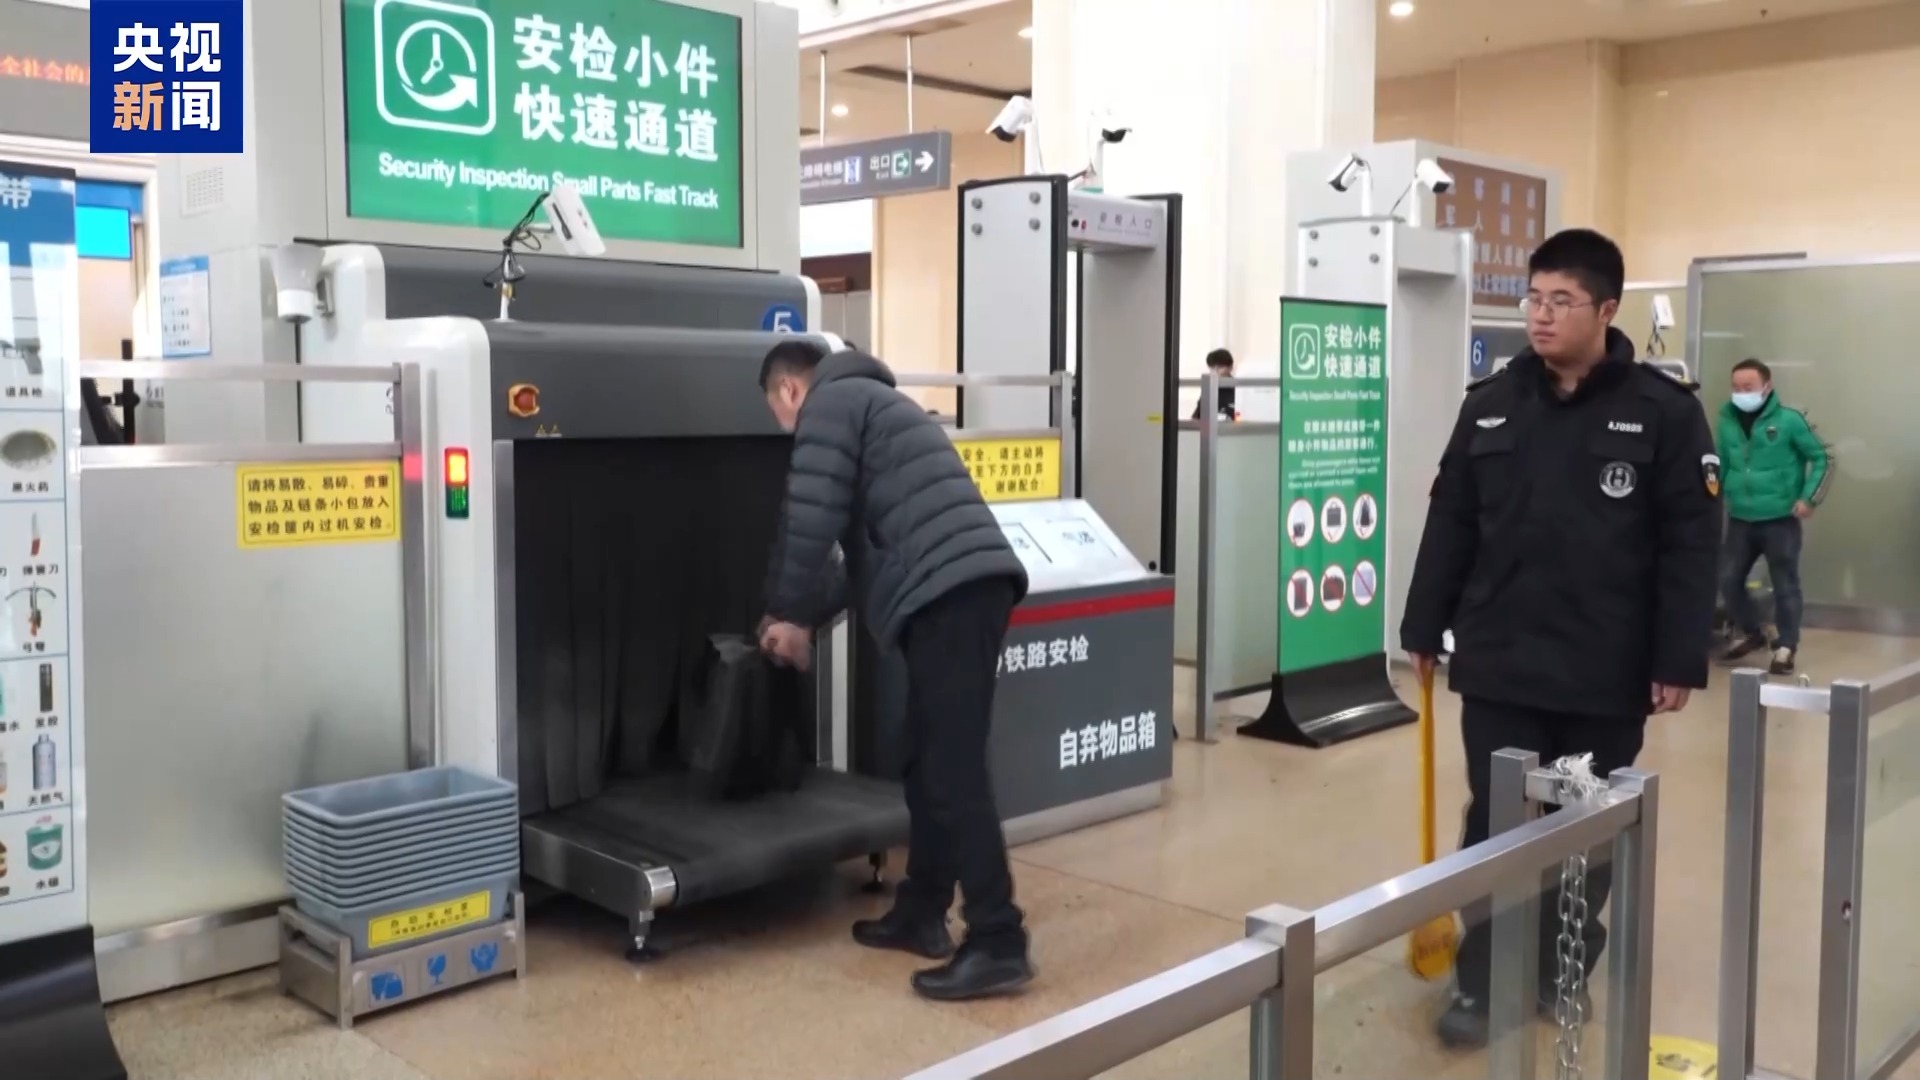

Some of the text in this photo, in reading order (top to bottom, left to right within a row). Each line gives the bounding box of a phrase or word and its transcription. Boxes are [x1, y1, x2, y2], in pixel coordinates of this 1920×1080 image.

[513, 14, 718, 98] 安检小件
[0, 54, 90, 86] 全社会的
[514, 81, 718, 162] 快速通道
[869, 154, 890, 170] 出口
[378, 152, 456, 188] Security
[459, 160, 549, 193] Inspection
[600, 179, 641, 201] Parts
[644, 182, 677, 204] Fast
[679, 185, 719, 210] Track
[773, 311, 794, 335] 5
[1324, 323, 1382, 349] 安检小件
[1472, 339, 1483, 366] 6
[1324, 353, 1382, 379] 快速通道
[967, 461, 1044, 478] 至下方的自弃
[976, 478, 1044, 493] ，谢谢配合
[248, 496, 390, 514] 物品及链条小包放入
[1005, 634, 1089, 675] 铁路安检
[1059, 710, 1157, 770] 自弃物品箱
